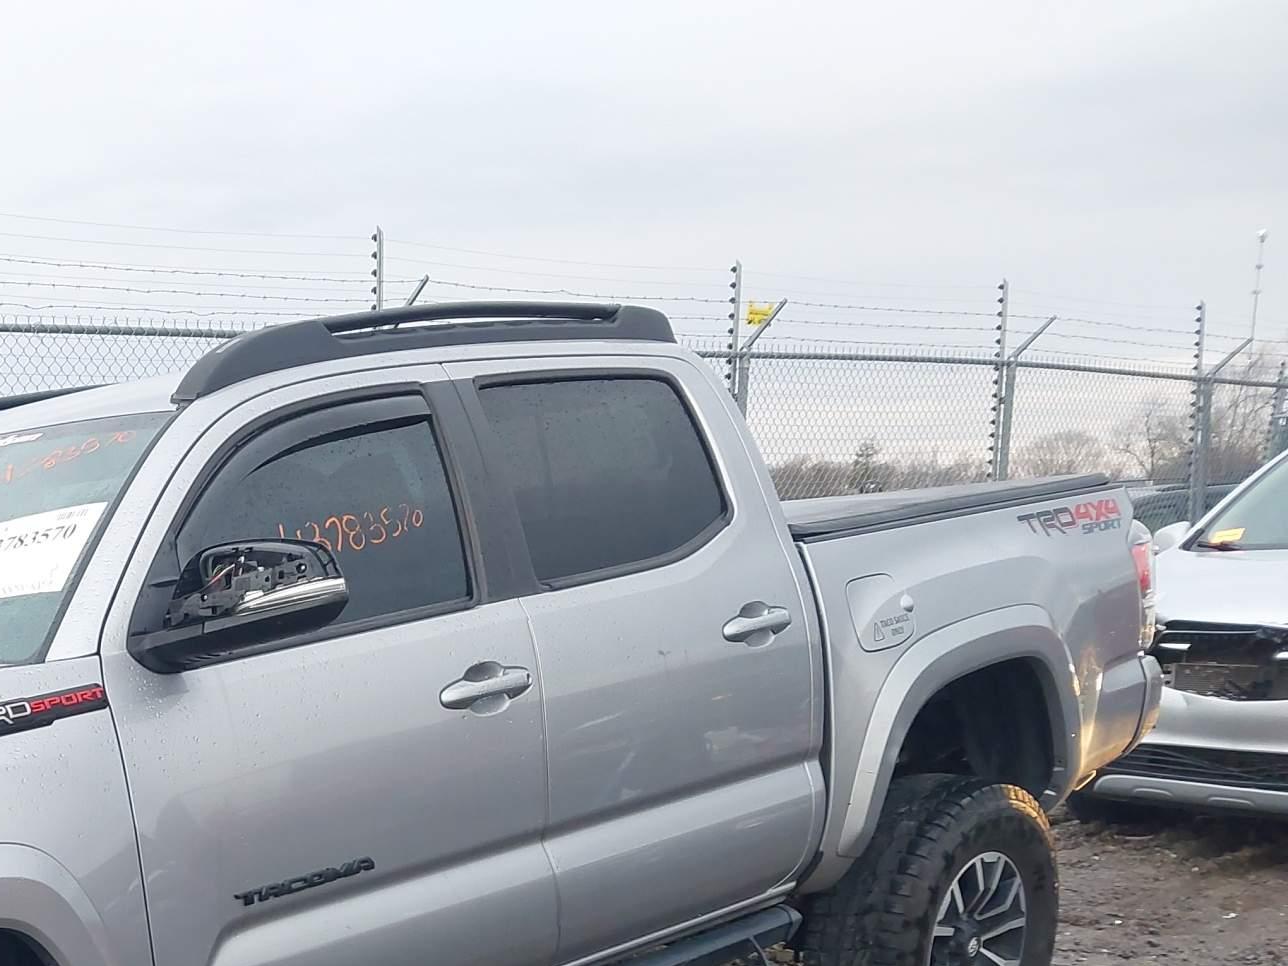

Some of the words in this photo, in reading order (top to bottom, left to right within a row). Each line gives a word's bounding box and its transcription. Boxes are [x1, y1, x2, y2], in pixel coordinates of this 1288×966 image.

[1017, 506, 1076, 536] TRD
[1082, 518, 1121, 535] SPORT
[30, 687, 104, 713] SPORT
[233, 855, 375, 906] TACOMA
